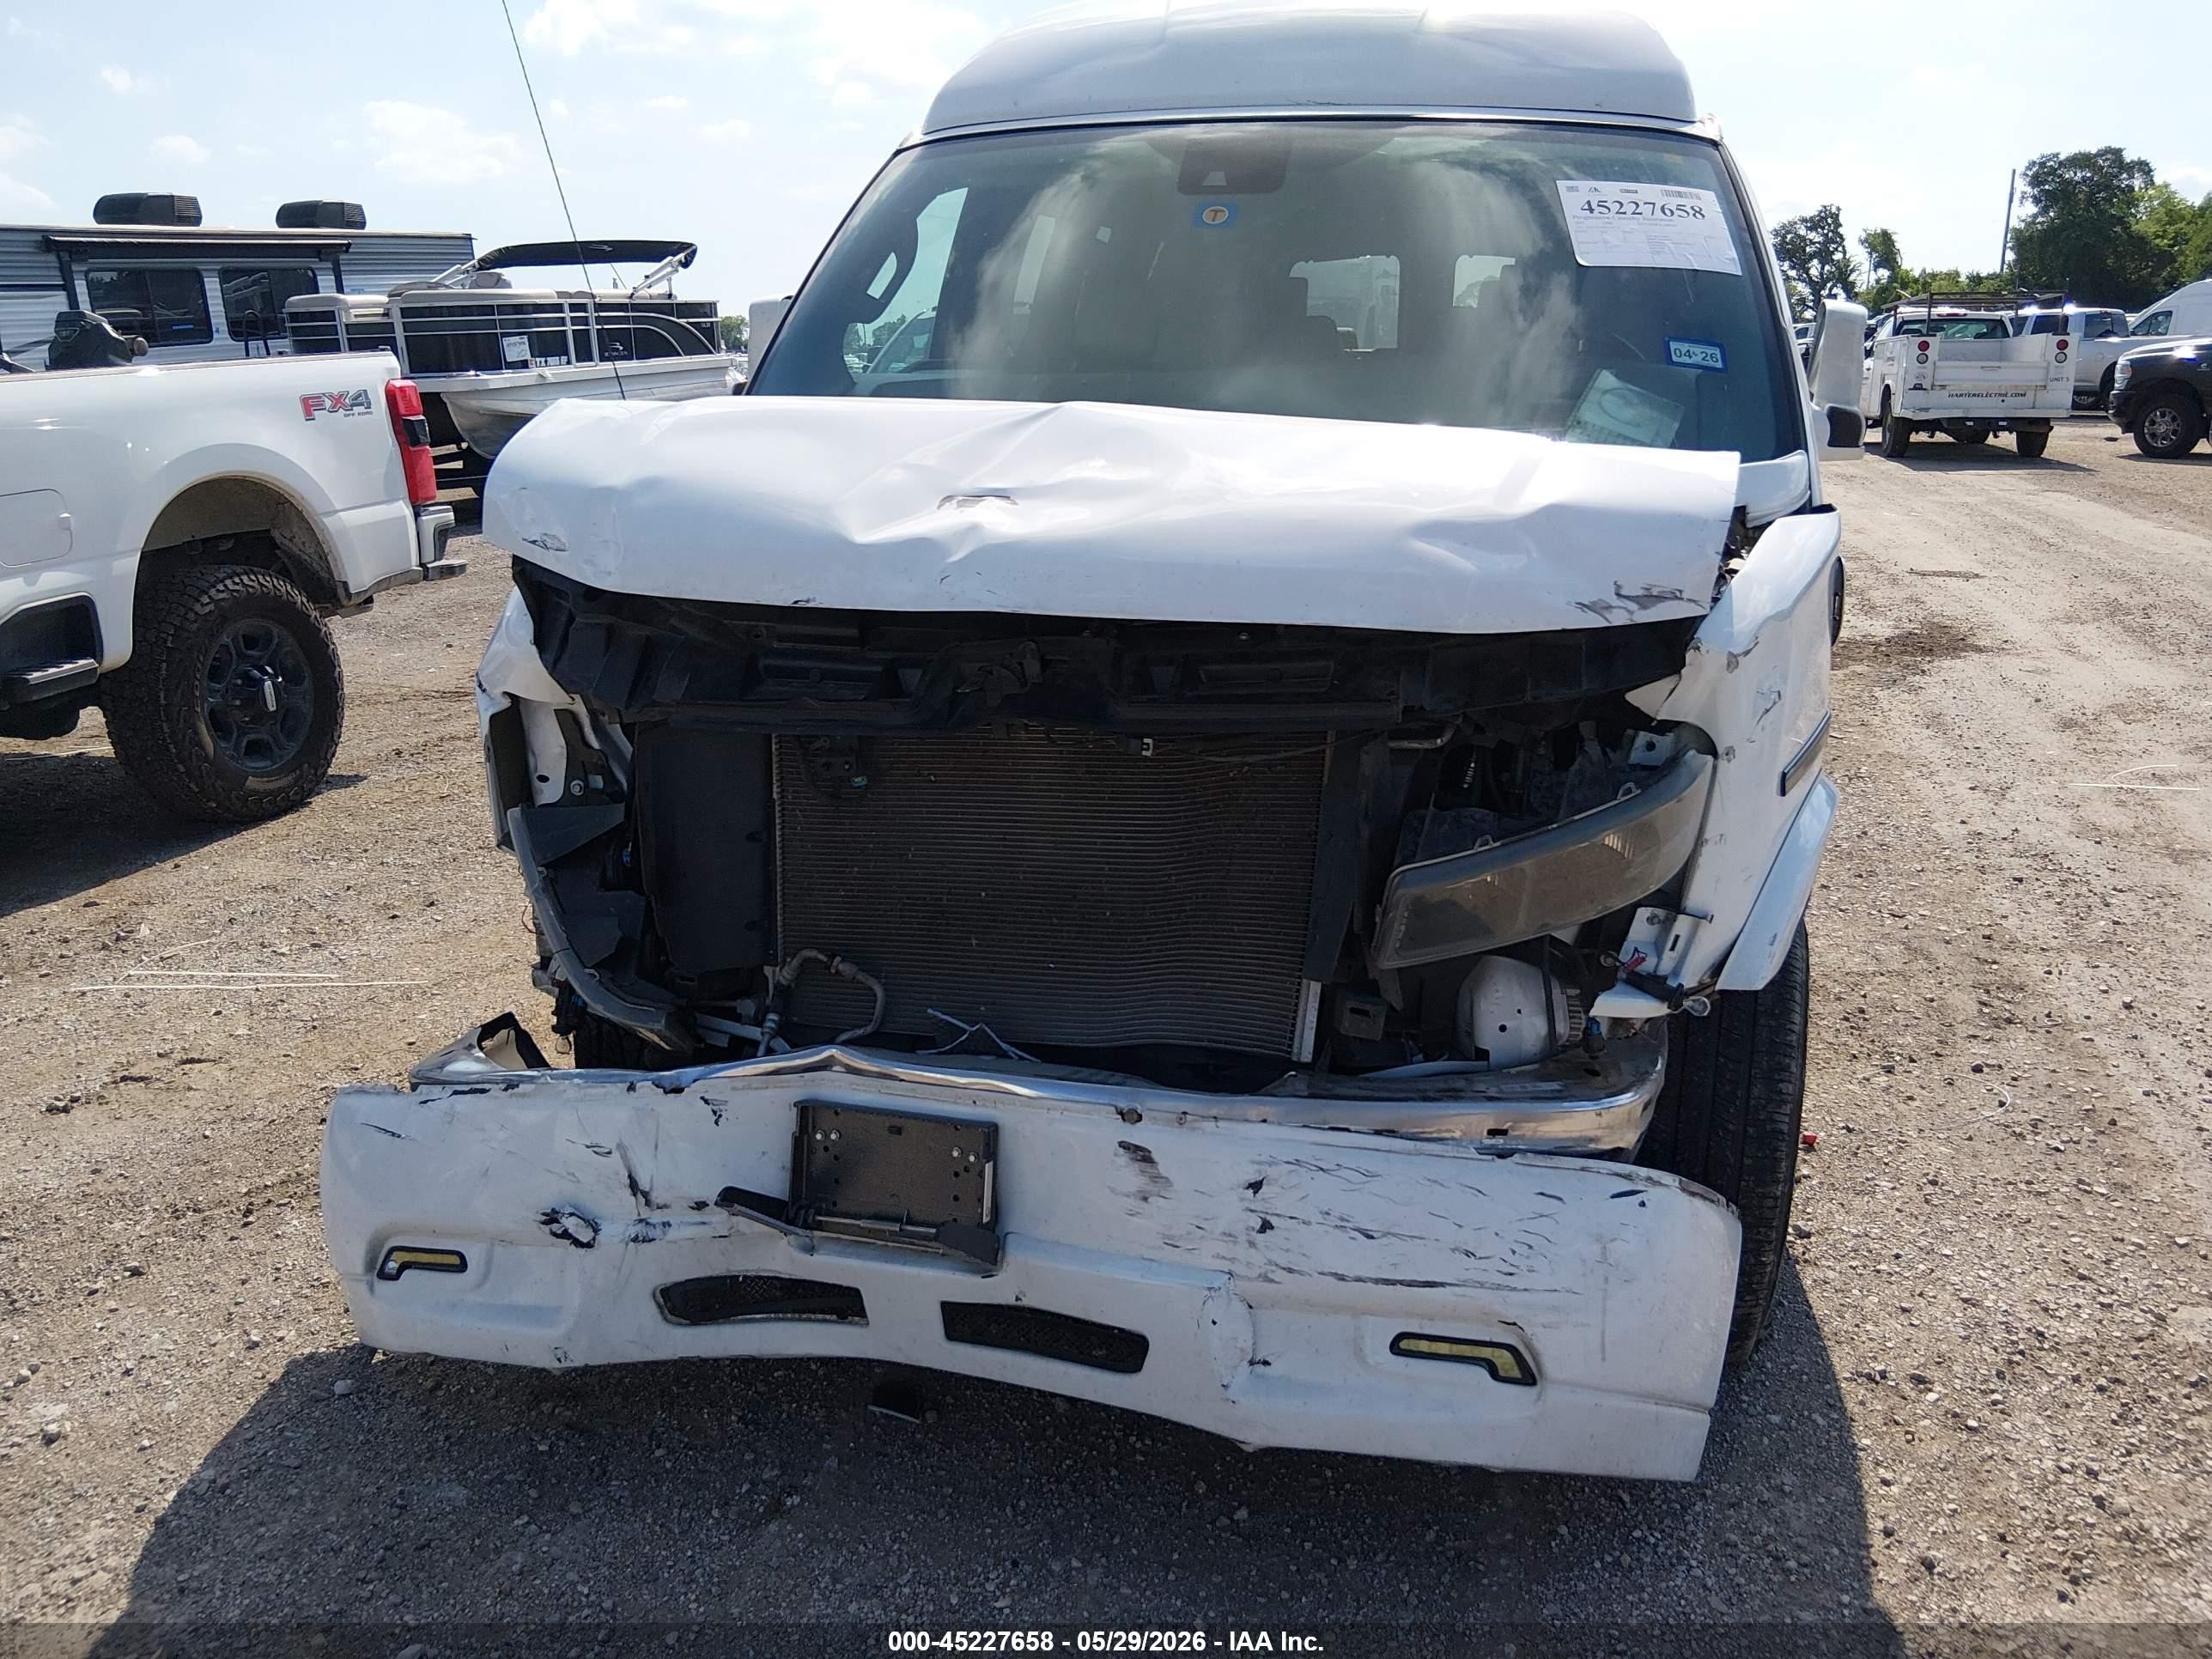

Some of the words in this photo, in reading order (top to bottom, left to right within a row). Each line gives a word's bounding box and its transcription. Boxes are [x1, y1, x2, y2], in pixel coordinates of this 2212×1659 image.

[1580, 199, 1706, 220] 45227658
[1674, 348, 1692, 359] 04
[1700, 351, 1719, 362] 26
[300, 389, 372, 421] FX4
